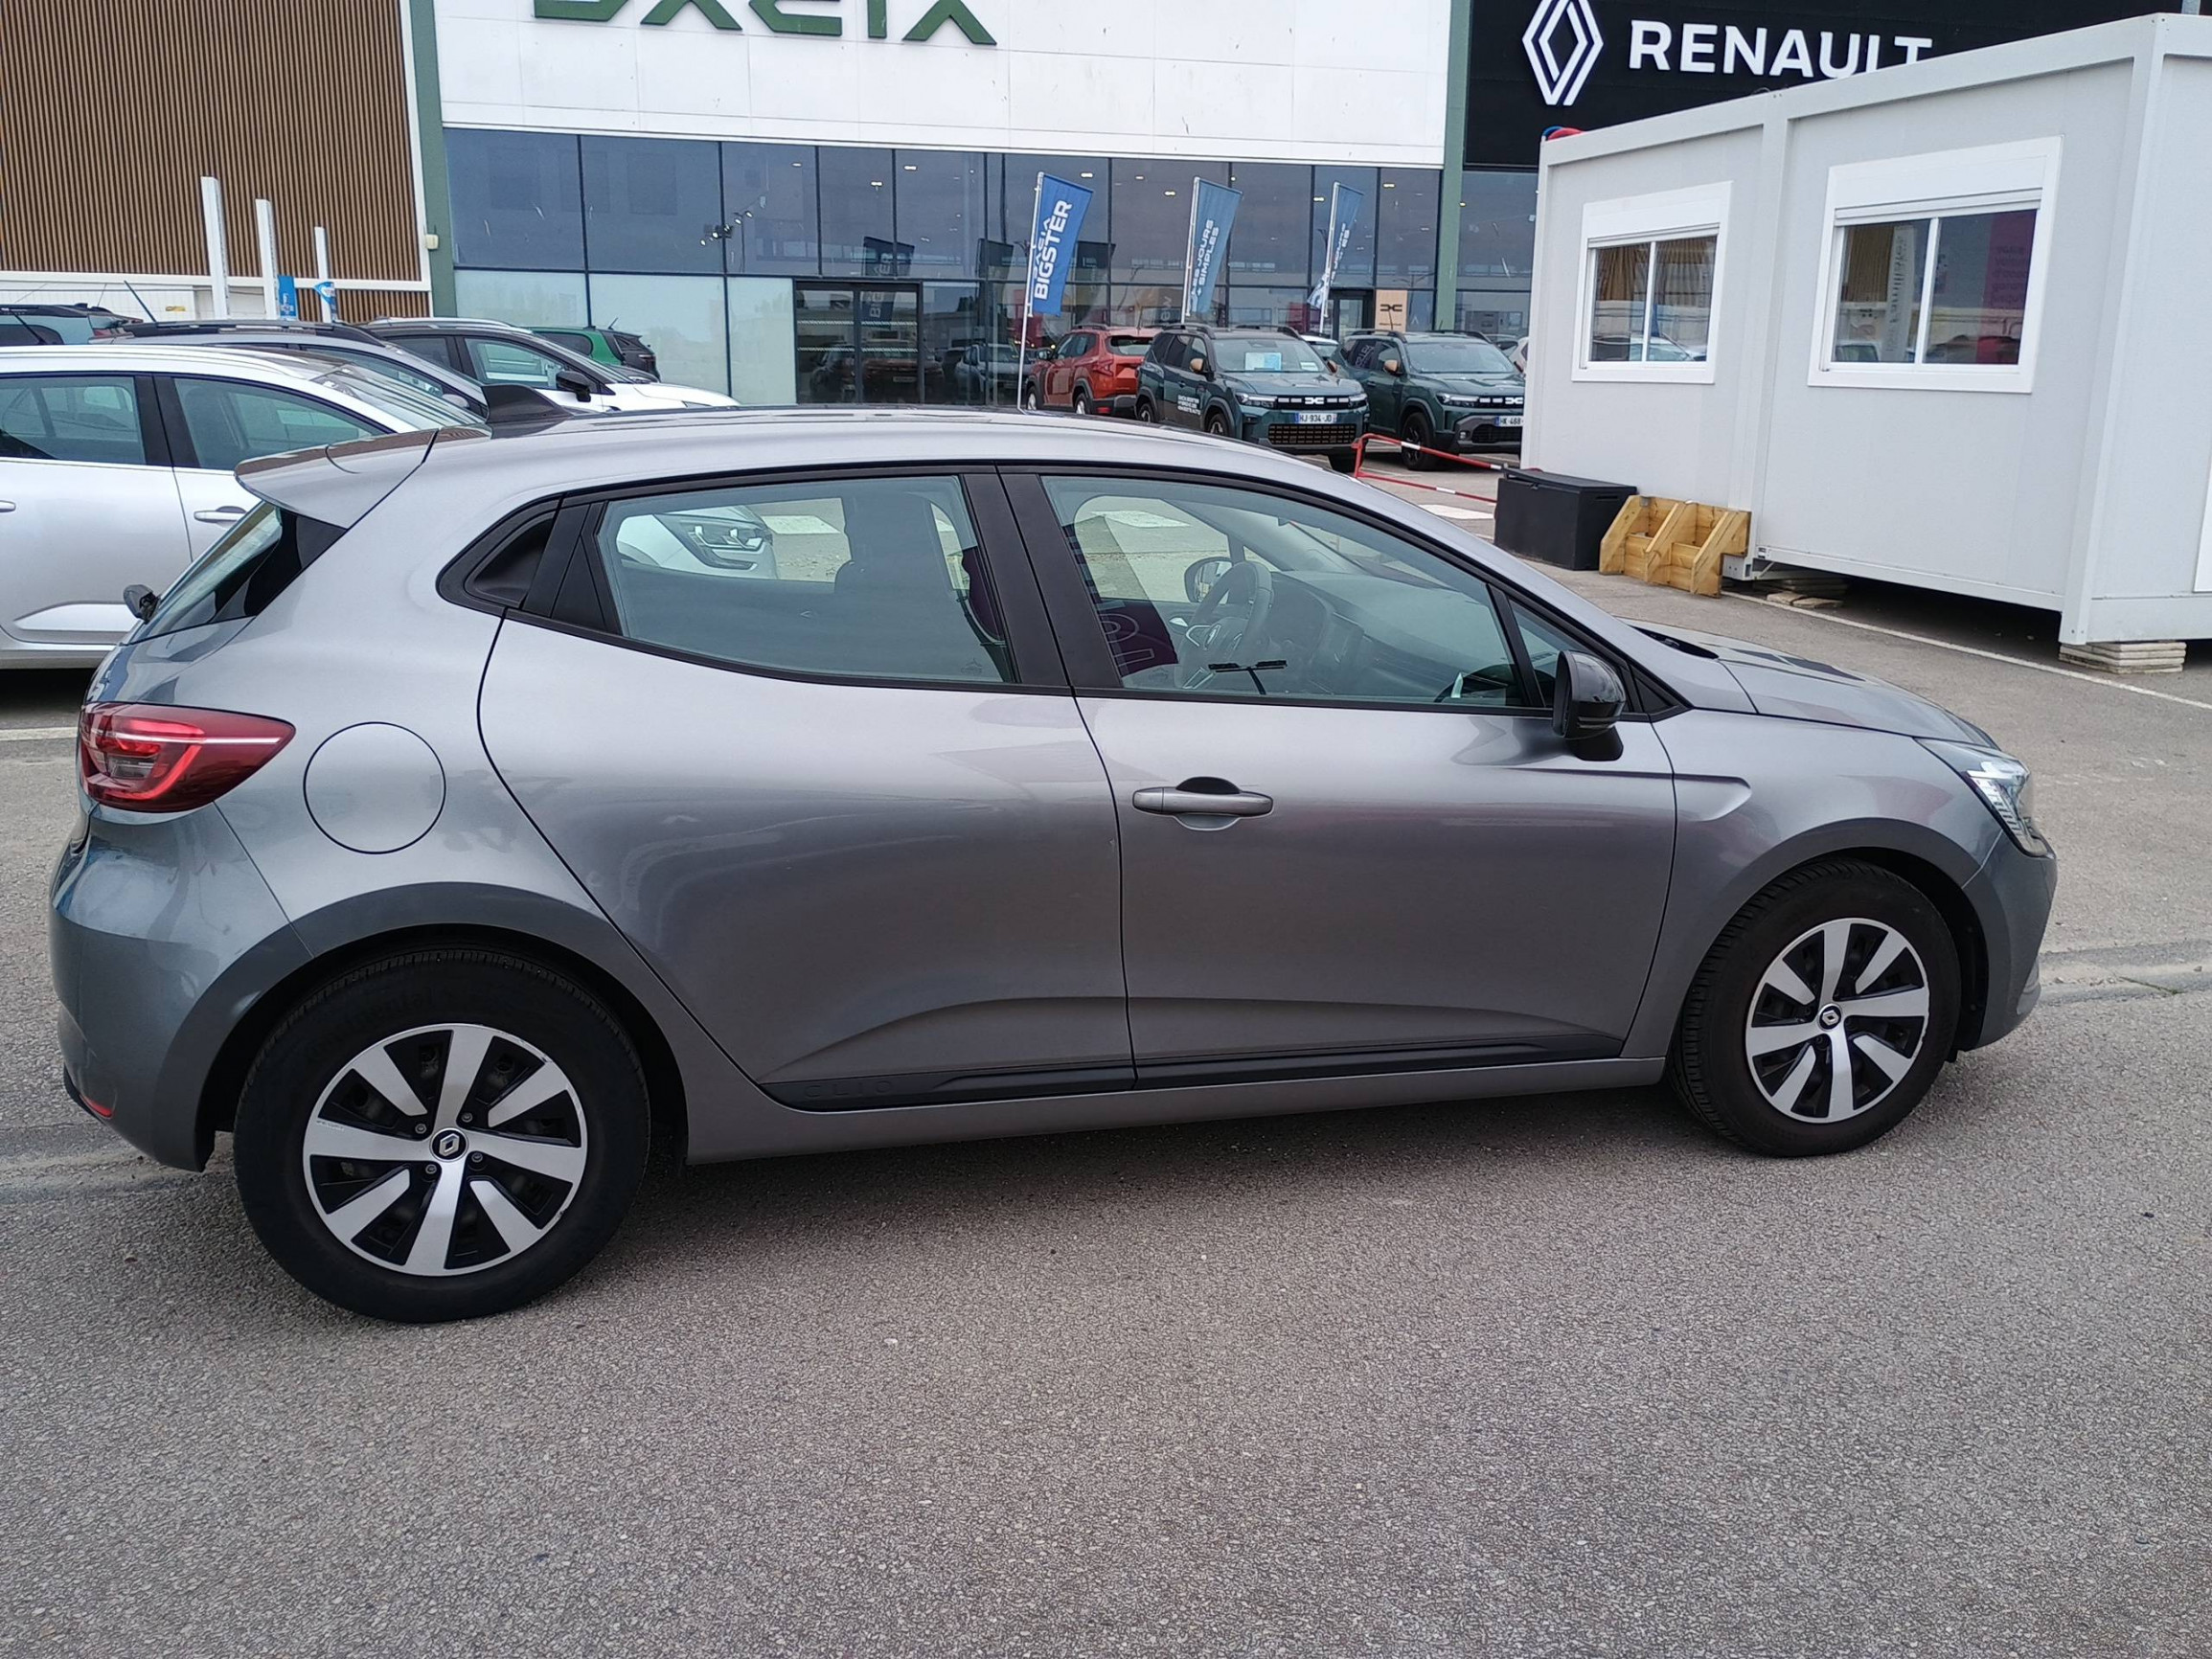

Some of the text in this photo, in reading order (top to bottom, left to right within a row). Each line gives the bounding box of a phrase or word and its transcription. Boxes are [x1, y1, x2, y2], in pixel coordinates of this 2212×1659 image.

[1034, 199, 1073, 300] BIGSTER
[1197, 219, 1214, 267] JOURS
[1198, 226, 1220, 286] SIMPLES
[804, 1079, 893, 1099] CLIO
